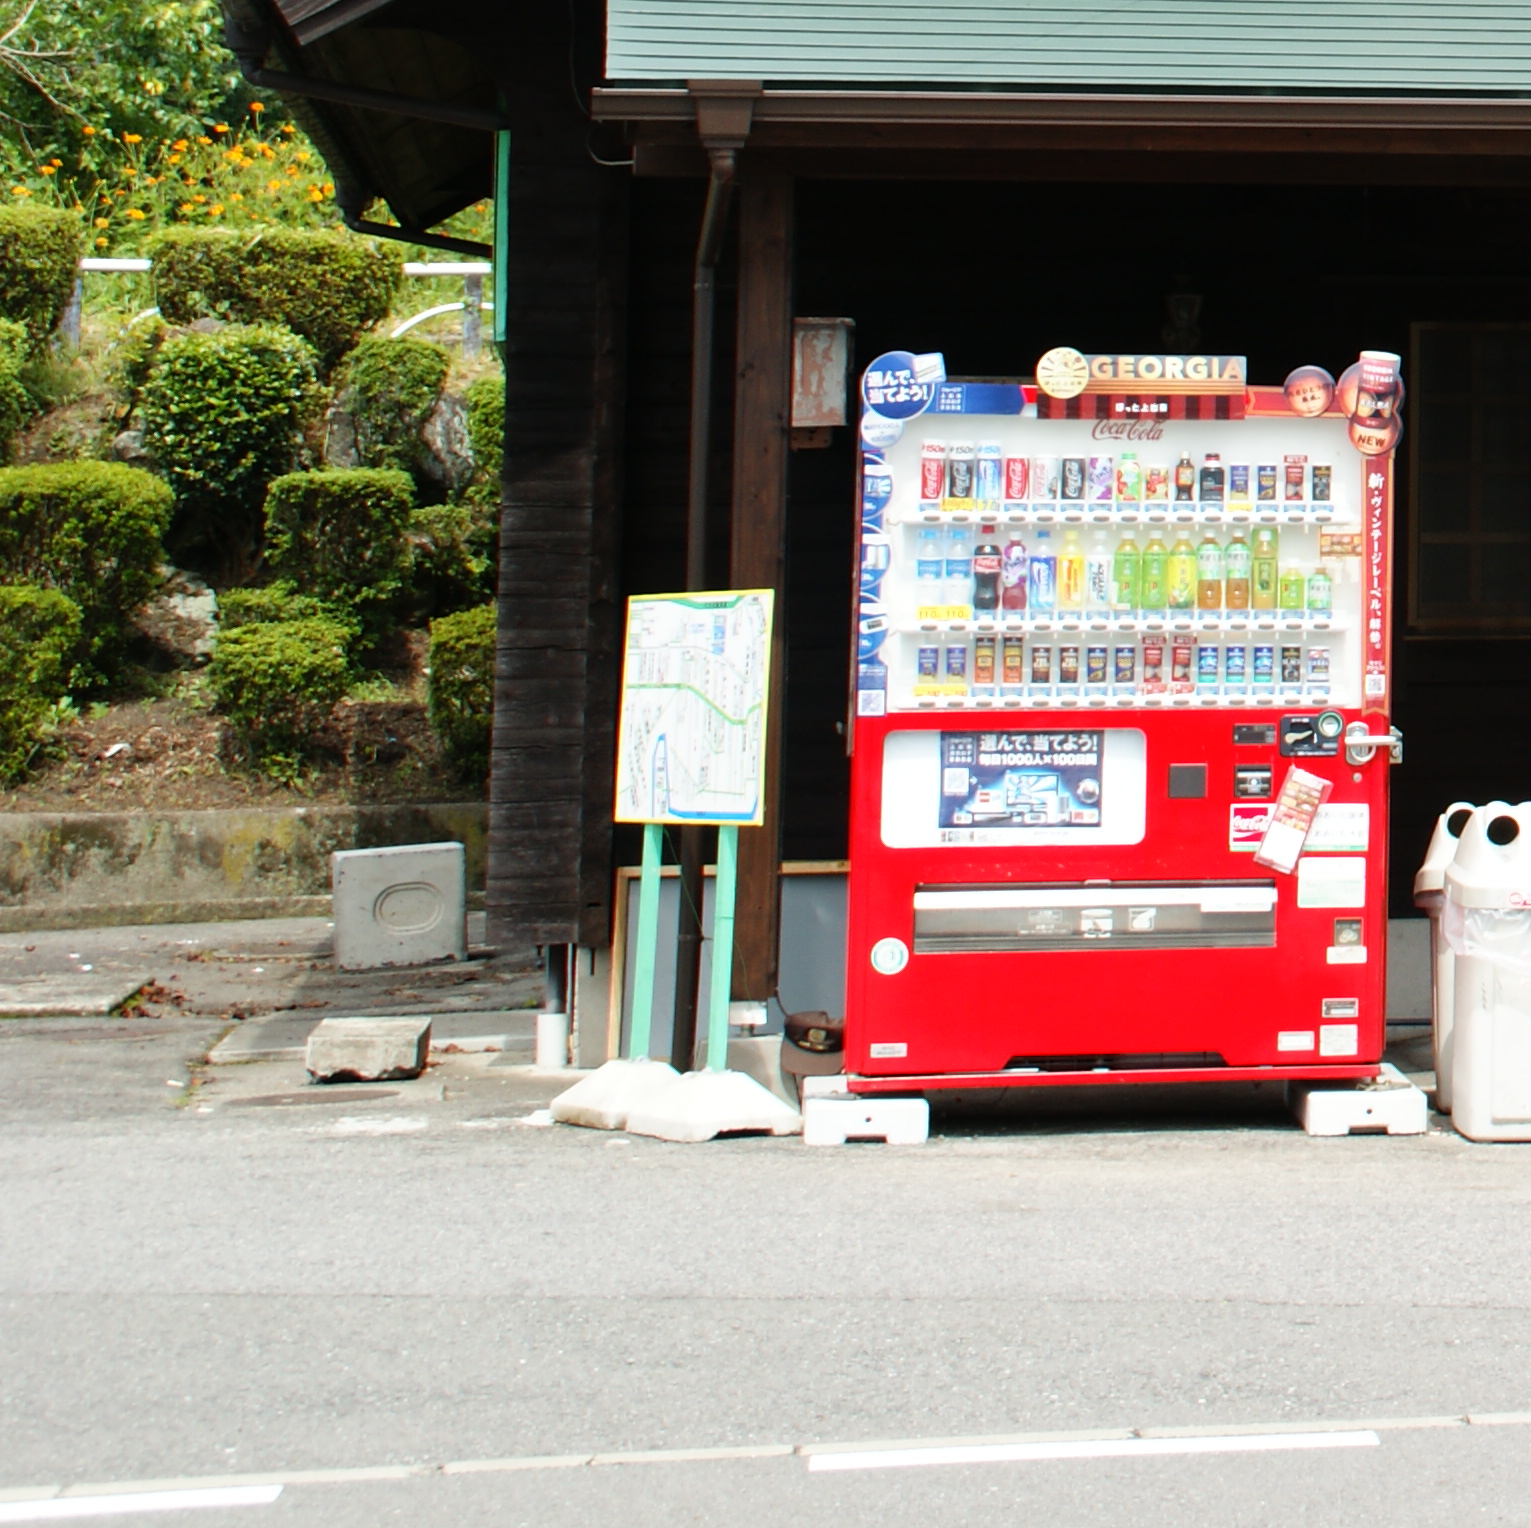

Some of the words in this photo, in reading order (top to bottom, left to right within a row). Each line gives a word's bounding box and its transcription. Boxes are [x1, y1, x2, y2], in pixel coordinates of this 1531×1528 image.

[1091, 356, 1244, 380] GEORGIA
[1092, 419, 1165, 441] Coca-Cola
[1357, 433, 1386, 448] NEW
